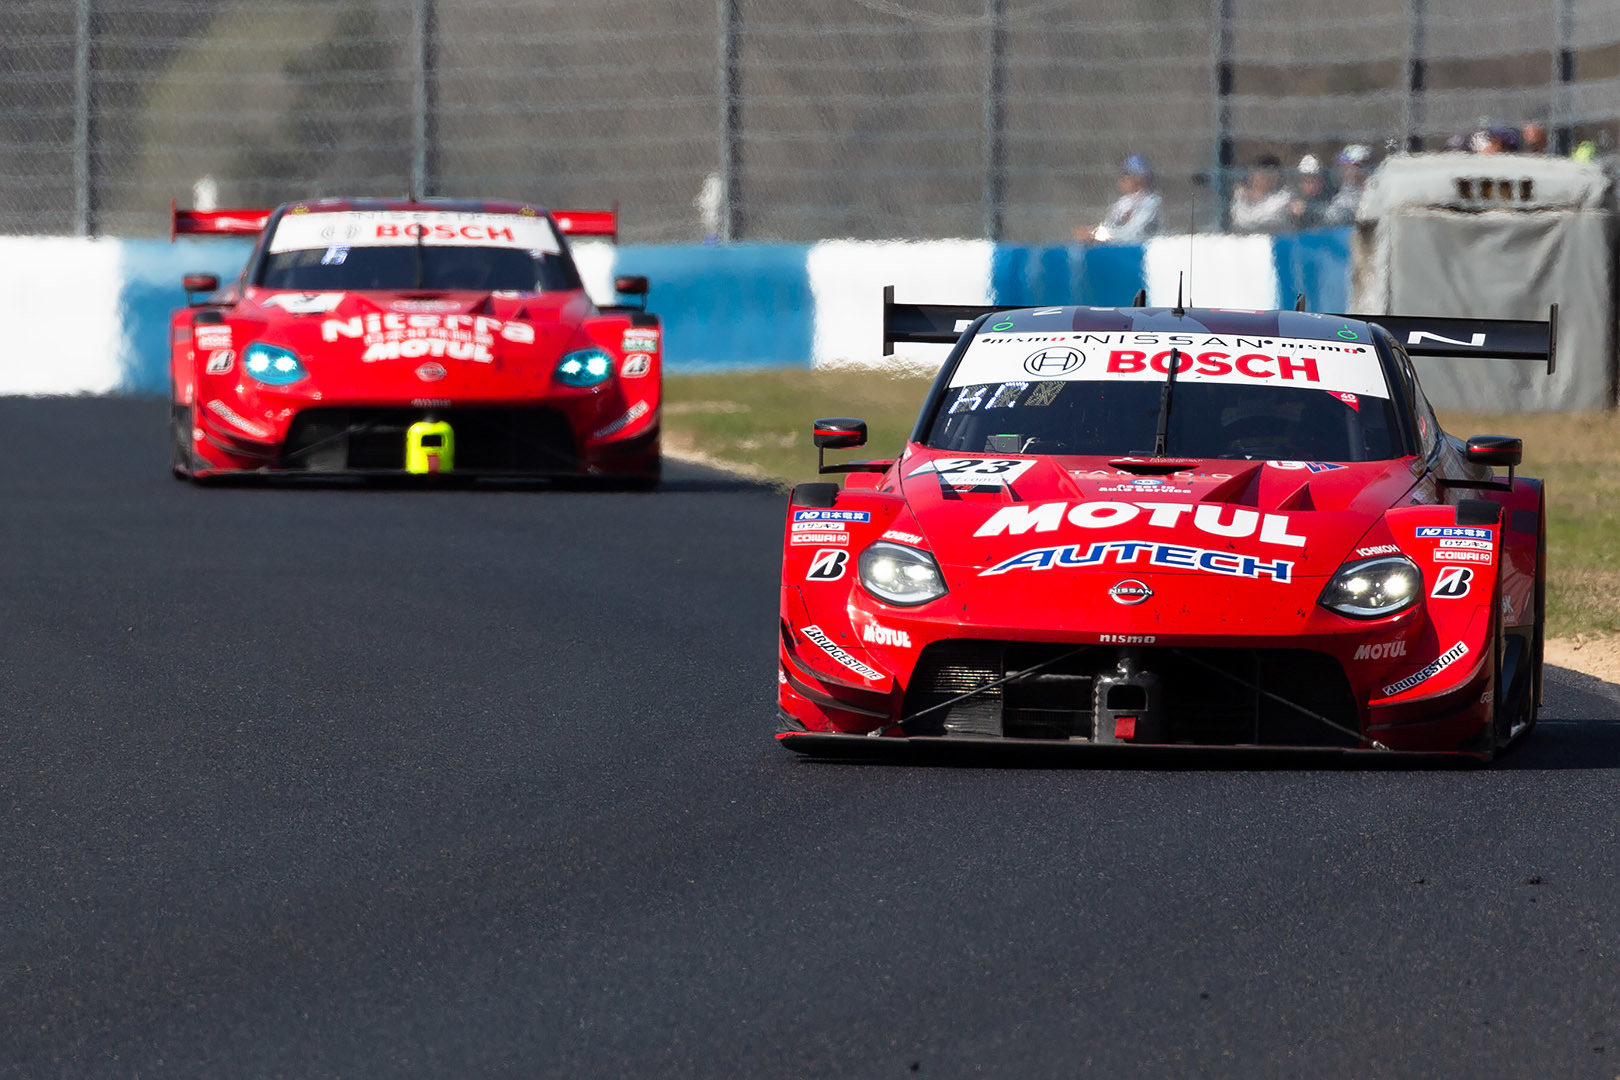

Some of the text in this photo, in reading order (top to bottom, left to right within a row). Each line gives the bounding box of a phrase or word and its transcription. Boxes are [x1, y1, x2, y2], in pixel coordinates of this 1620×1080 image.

[375, 224, 515, 242] BOSCH
[321, 313, 535, 344] Niterra
[361, 338, 494, 363] MOTUL
[1083, 334, 1262, 348] NISSAN
[1106, 350, 1320, 382] BOSCH
[938, 459, 1022, 475] 23
[972, 501, 1306, 547] MOTUL
[977, 540, 1295, 584] AUTECH
[1356, 544, 1400, 557] ICHIKOH
[1108, 586, 1154, 596] NISSAN
[863, 624, 912, 648] MOTUL
[1099, 633, 1156, 644] nismo
[802, 625, 883, 680] BRIDGESTONE
[1353, 640, 1407, 660] MOTUL
[1384, 641, 1468, 695] BRIDGESTONE
